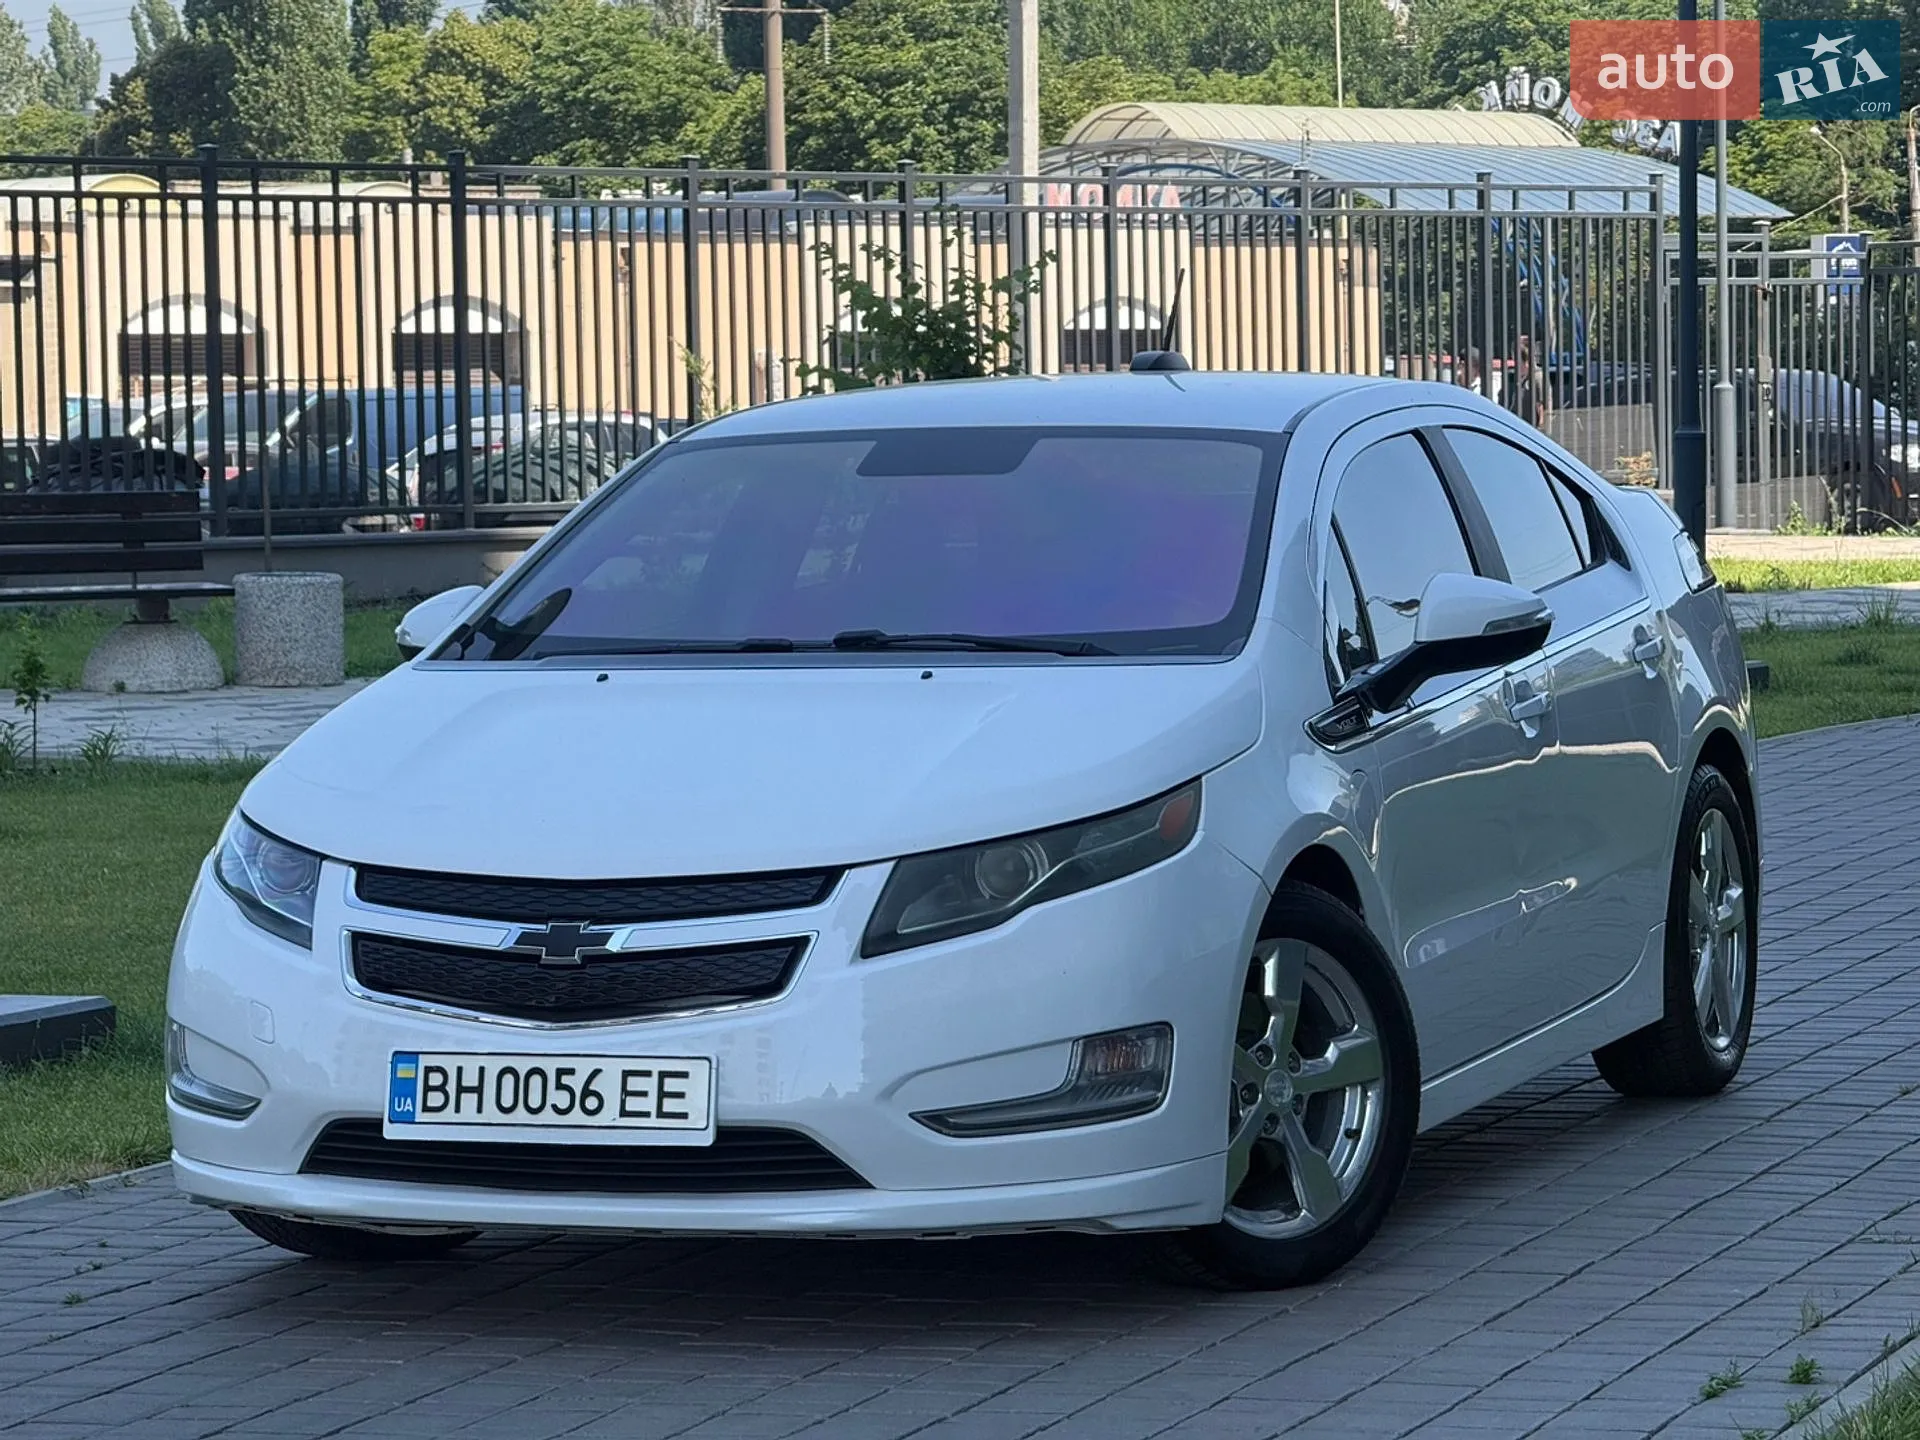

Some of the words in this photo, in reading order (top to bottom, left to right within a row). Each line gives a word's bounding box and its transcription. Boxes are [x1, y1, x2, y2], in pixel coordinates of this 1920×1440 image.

[394, 1096, 414, 1113] UA
[421, 1065, 485, 1114] BH
[495, 1066, 605, 1117] 0056
[619, 1069, 690, 1120] EE
